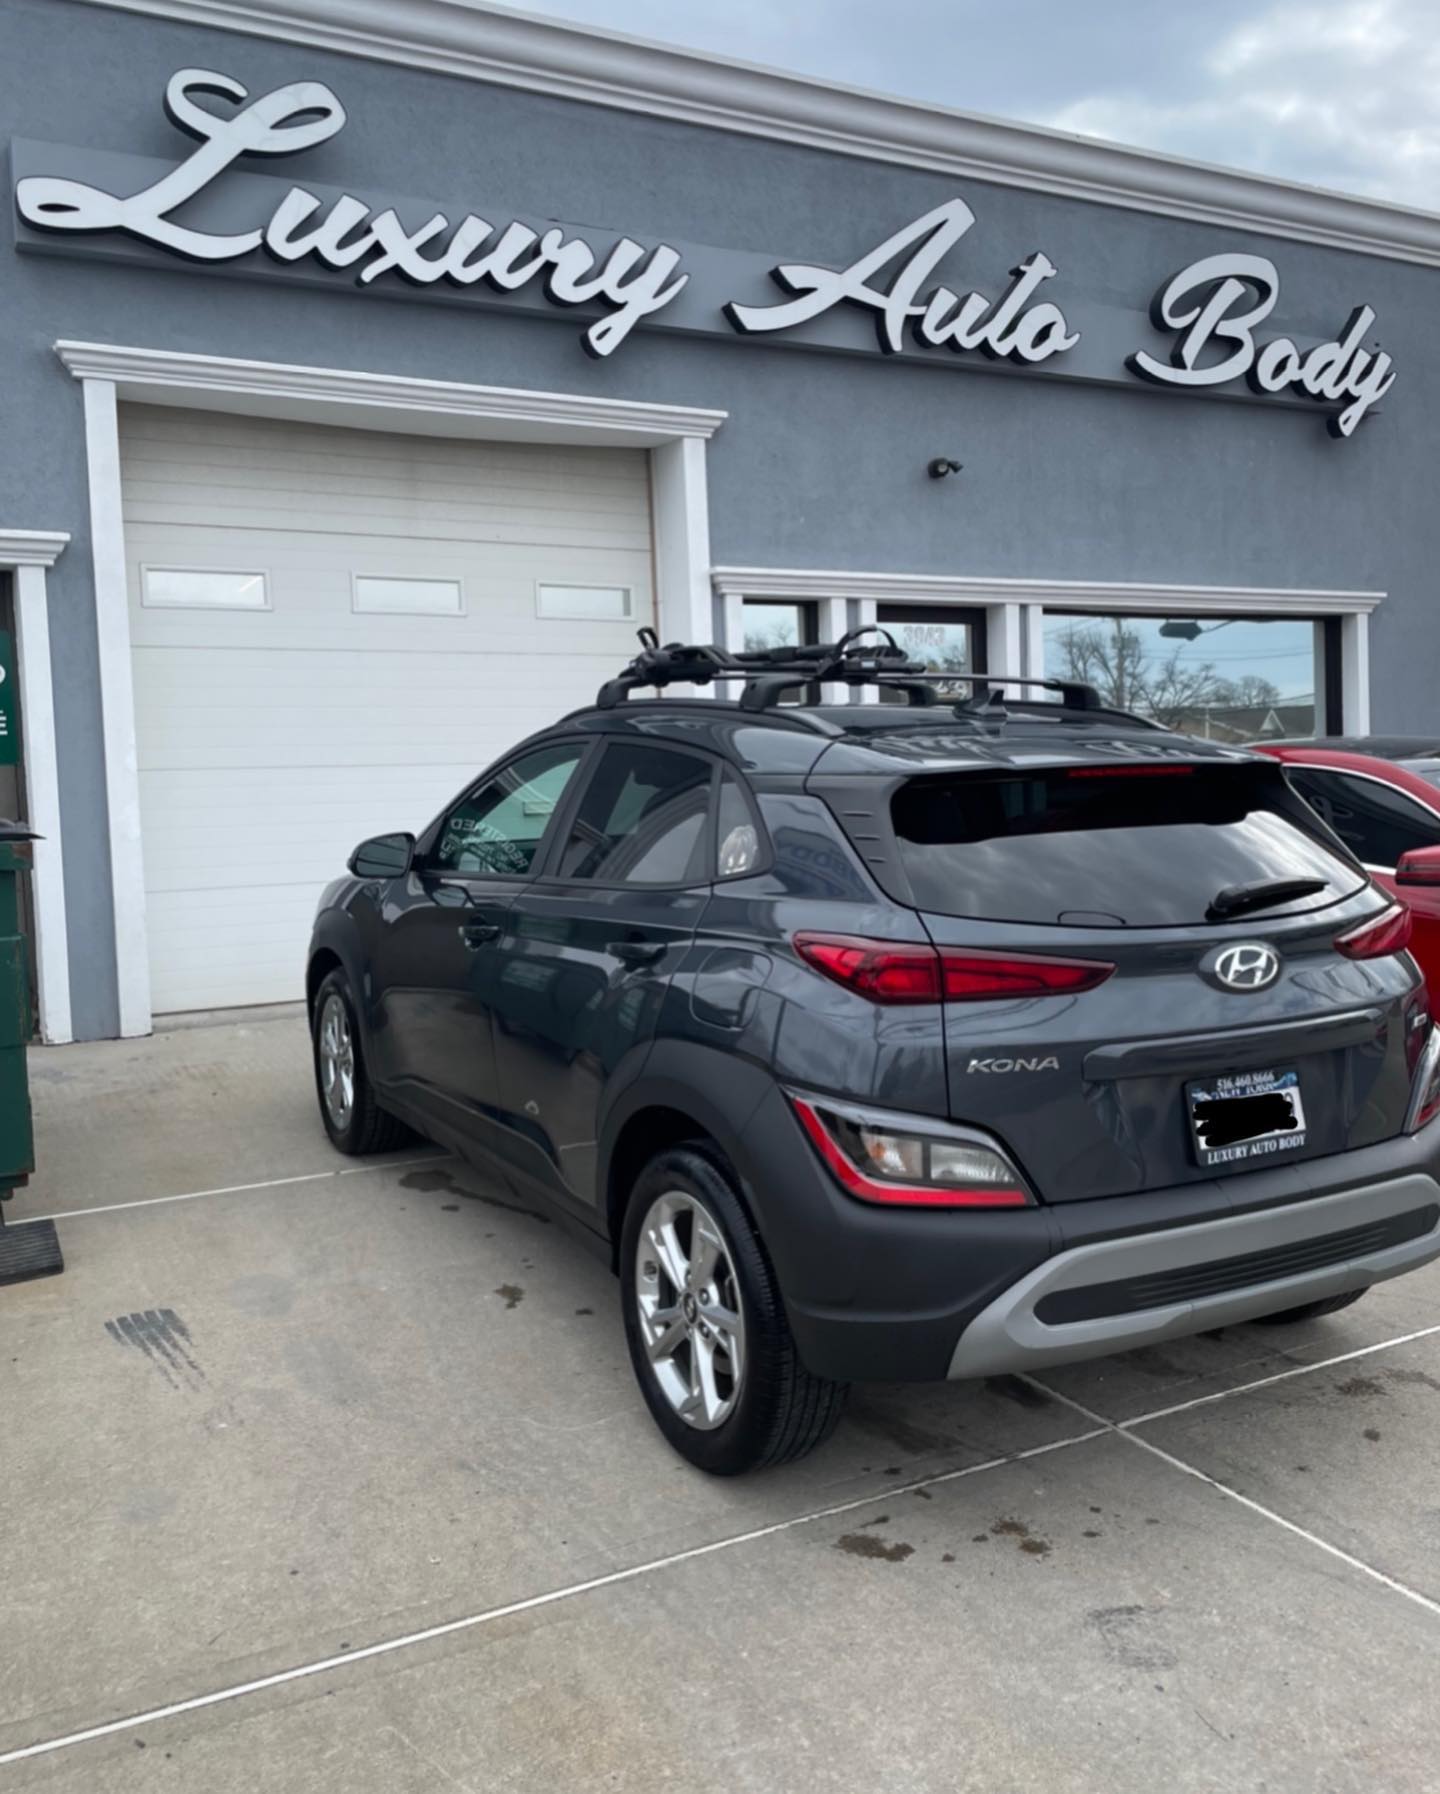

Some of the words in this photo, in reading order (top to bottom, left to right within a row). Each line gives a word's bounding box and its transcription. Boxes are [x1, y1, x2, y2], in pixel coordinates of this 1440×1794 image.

[16, 67, 690, 358] Luxury
[728, 198, 1080, 362] Auto
[1130, 252, 1397, 438] Body
[966, 1056, 1060, 1074] KONA
[1207, 1146, 1249, 1165] LUXURY
[1250, 1139, 1277, 1156] AUTO
[1279, 1134, 1306, 1150] BODY
